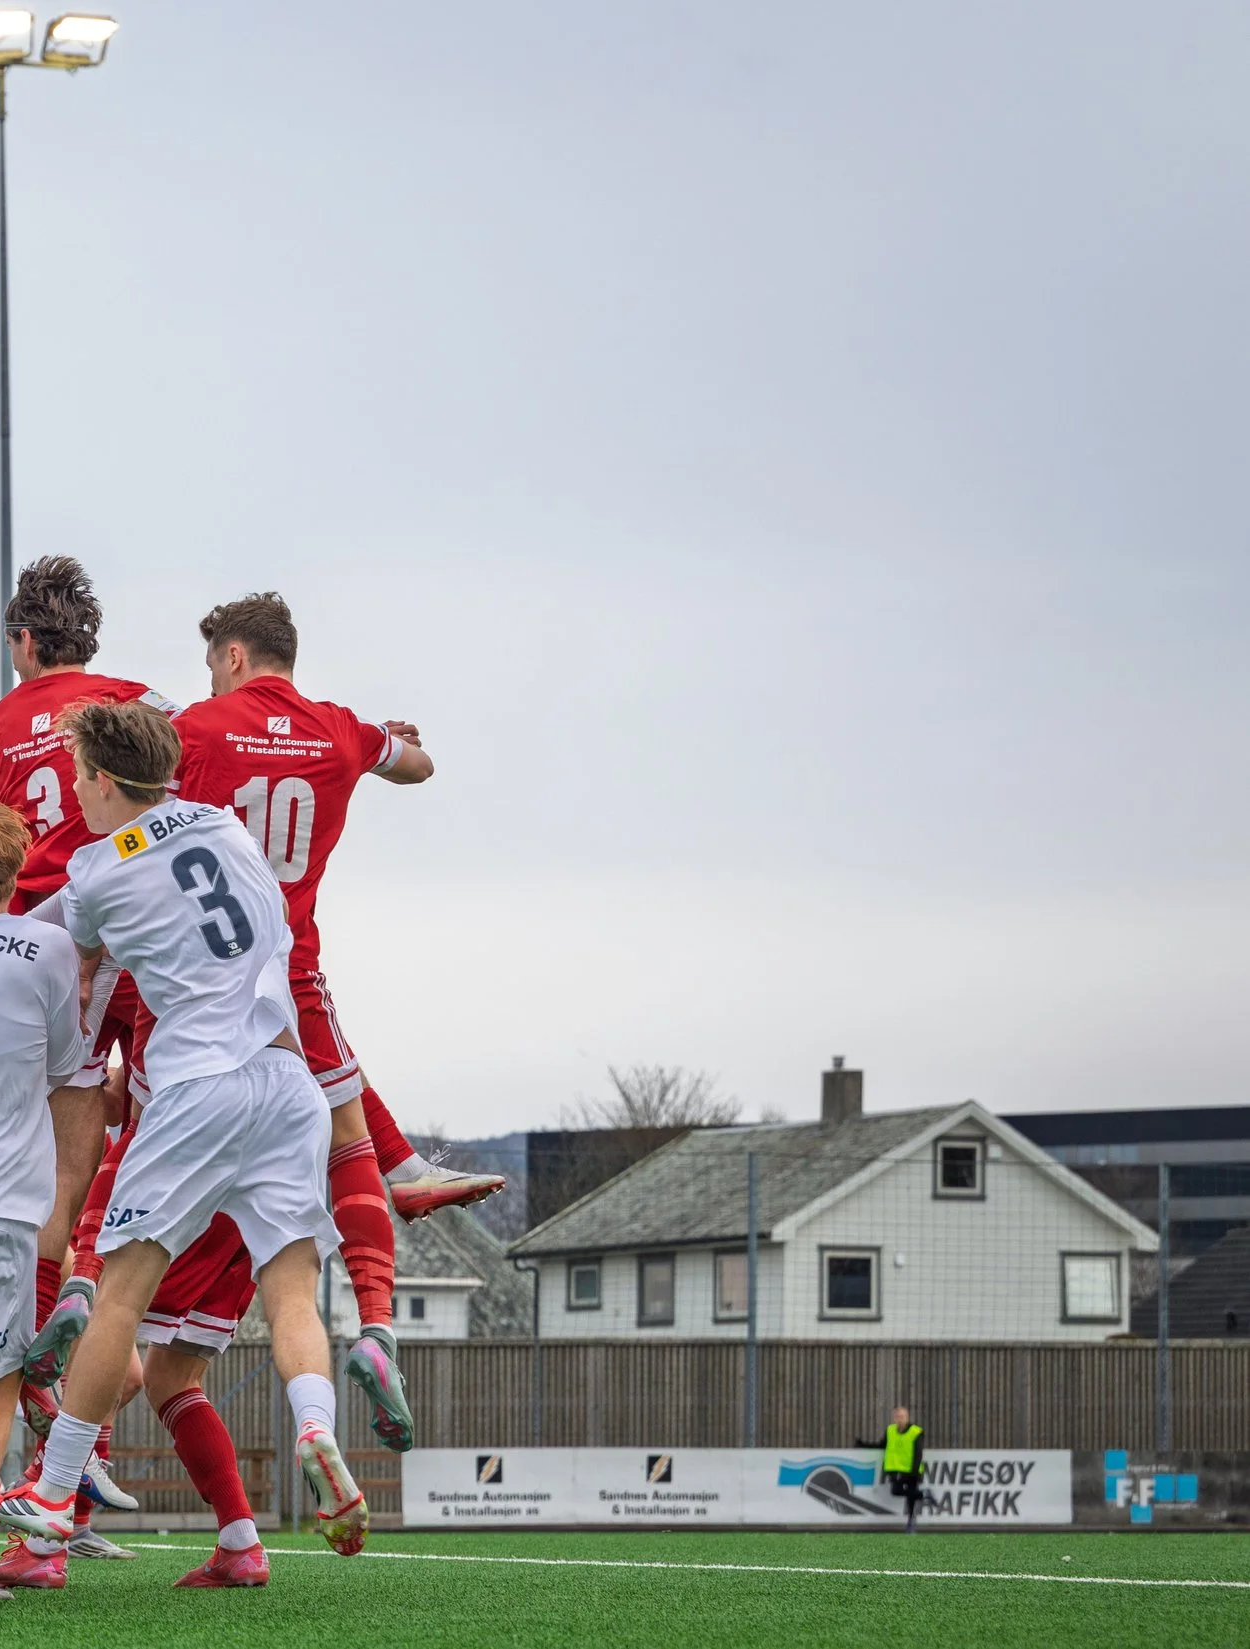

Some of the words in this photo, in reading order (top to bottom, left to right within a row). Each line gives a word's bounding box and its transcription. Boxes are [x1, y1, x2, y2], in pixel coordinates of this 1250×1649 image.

[2, 740, 35, 756] Sandnes
[225, 733, 269, 745] Sandnes
[272, 736, 333, 749] Automasjon
[236, 744, 244, 752] &
[247, 745, 306, 757] Installasjon
[309, 749, 322, 757] as
[26, 766, 65, 838] 3
[149, 806, 219, 842] BACKE
[234, 776, 316, 883] 10
[170, 846, 255, 961] 3
[104, 1207, 150, 1228] SAT
